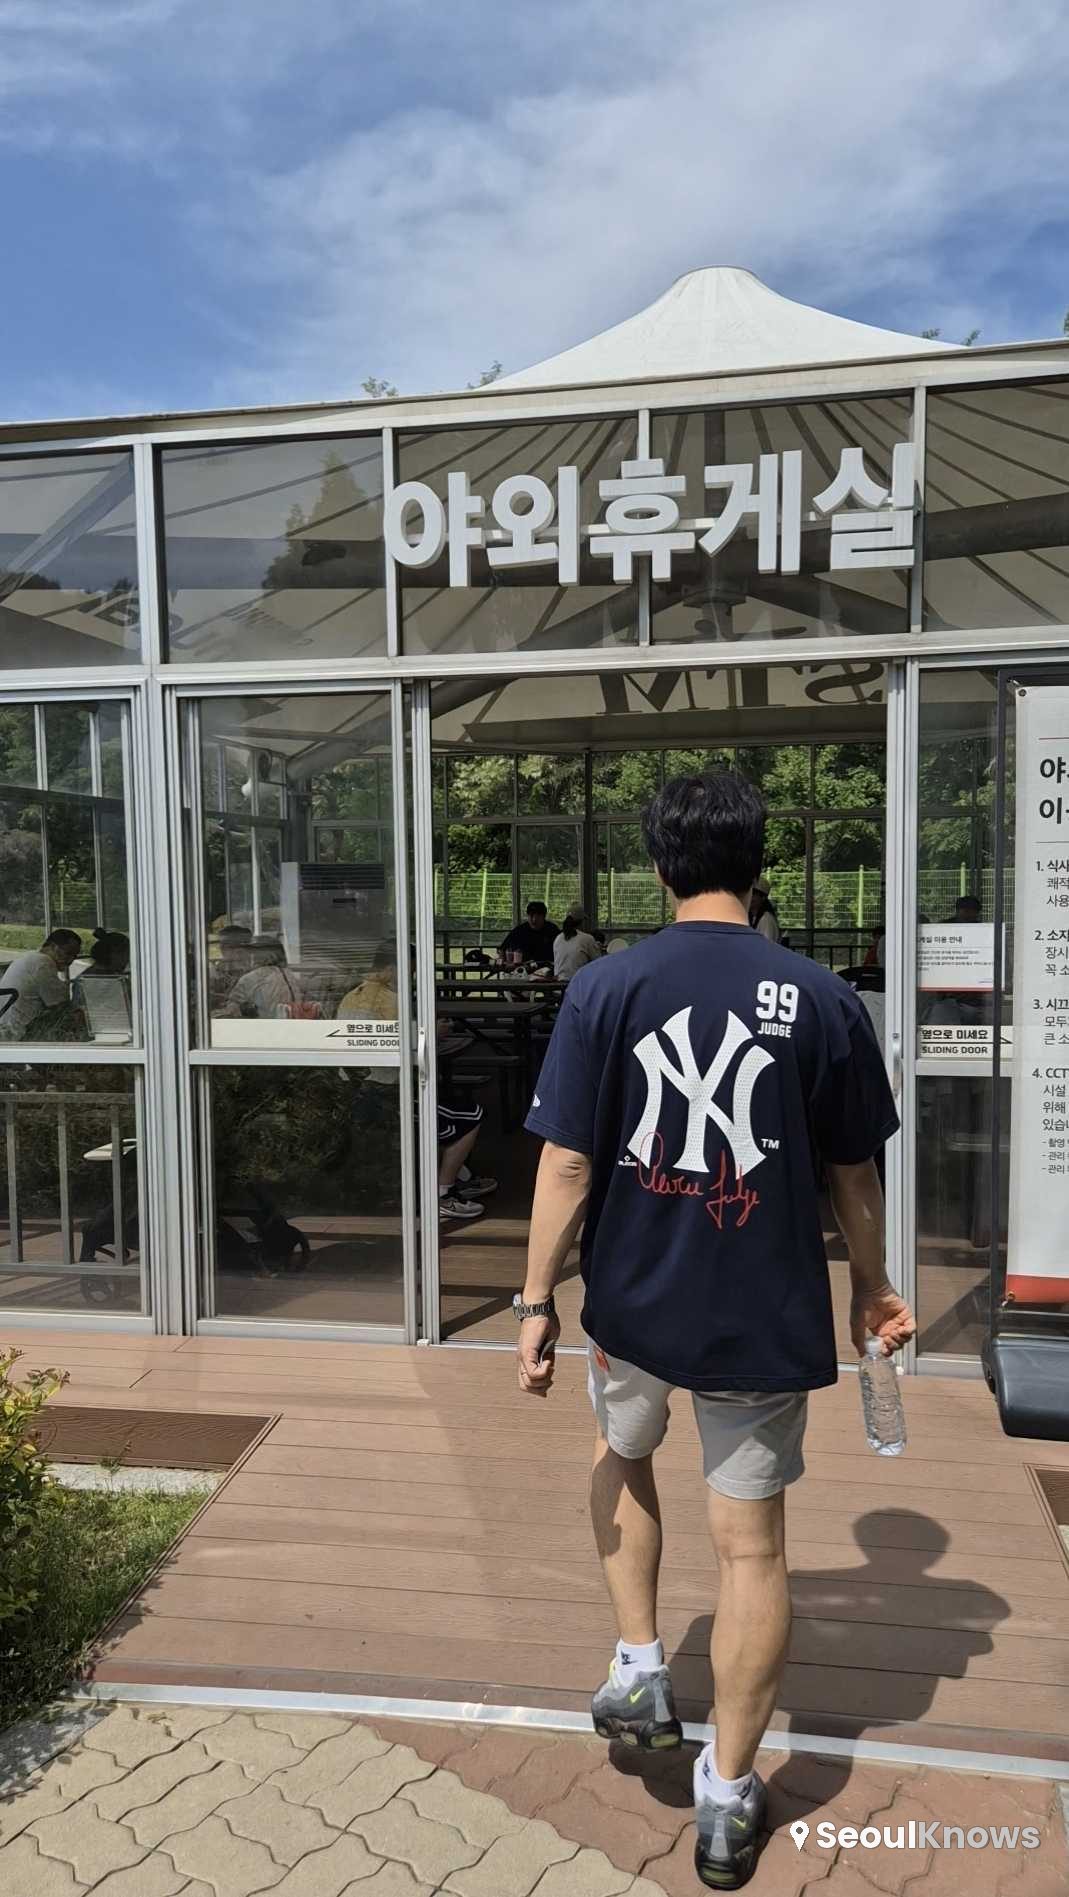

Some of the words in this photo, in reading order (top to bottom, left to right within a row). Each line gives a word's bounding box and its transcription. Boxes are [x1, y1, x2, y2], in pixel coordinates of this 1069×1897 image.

[383, 443, 915, 588] 야외휴게실
[1040, 756, 1069, 784] 야
[1039, 797, 1069, 825] 이
[1036, 861, 1045, 872] 1.
[1046, 894, 1069, 908] 사용
[1034, 929, 1044, 941] 2.
[1045, 946, 1069, 960] 장시
[1045, 963, 1056, 977] 꼭
[755, 980, 800, 1023] 99
[1033, 998, 1043, 1010] 3.
[347, 1024, 373, 1033] 옆으로
[1043, 1015, 1069, 1029] 모두
[757, 1021, 792, 1039] JUDGE
[922, 1029, 953, 1040] 옆으로
[956, 1029, 988, 1040] 미세요
[346, 1039, 378, 1047] SLIDING
[1044, 1032, 1056, 1046] 큰
[922, 1045, 958, 1054] SLIDING
[961, 1045, 988, 1054] DOOR
[1032, 1067, 1042, 1079] 4.
[1046, 1067, 1069, 1079] CCT
[1043, 1084, 1066, 1098] 시설
[1042, 1101, 1066, 1115] 위해
